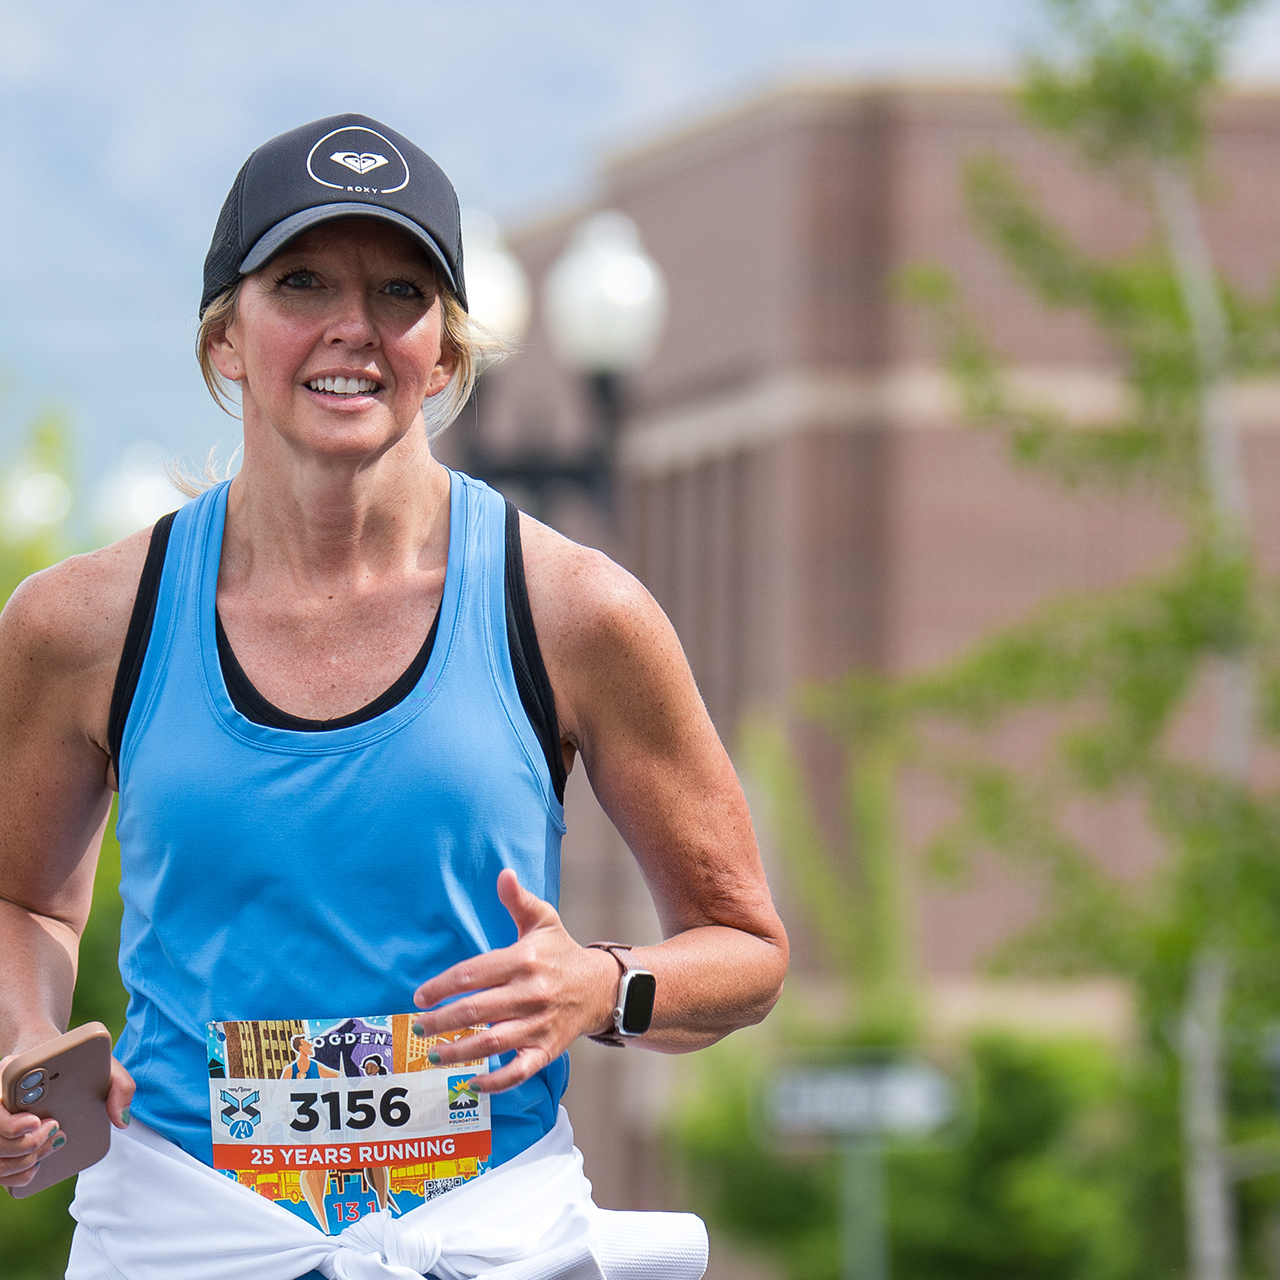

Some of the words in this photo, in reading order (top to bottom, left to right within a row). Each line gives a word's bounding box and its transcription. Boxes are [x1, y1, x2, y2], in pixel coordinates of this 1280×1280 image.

[347, 186, 378, 194] ROXY
[312, 1032, 387, 1048] OGDEN
[289, 1087, 411, 1132] 3156
[449, 1110, 479, 1120] GOAL
[250, 1148, 274, 1165] 25
[280, 1147, 352, 1165] YEARS
[359, 1138, 456, 1163] RUNNING
